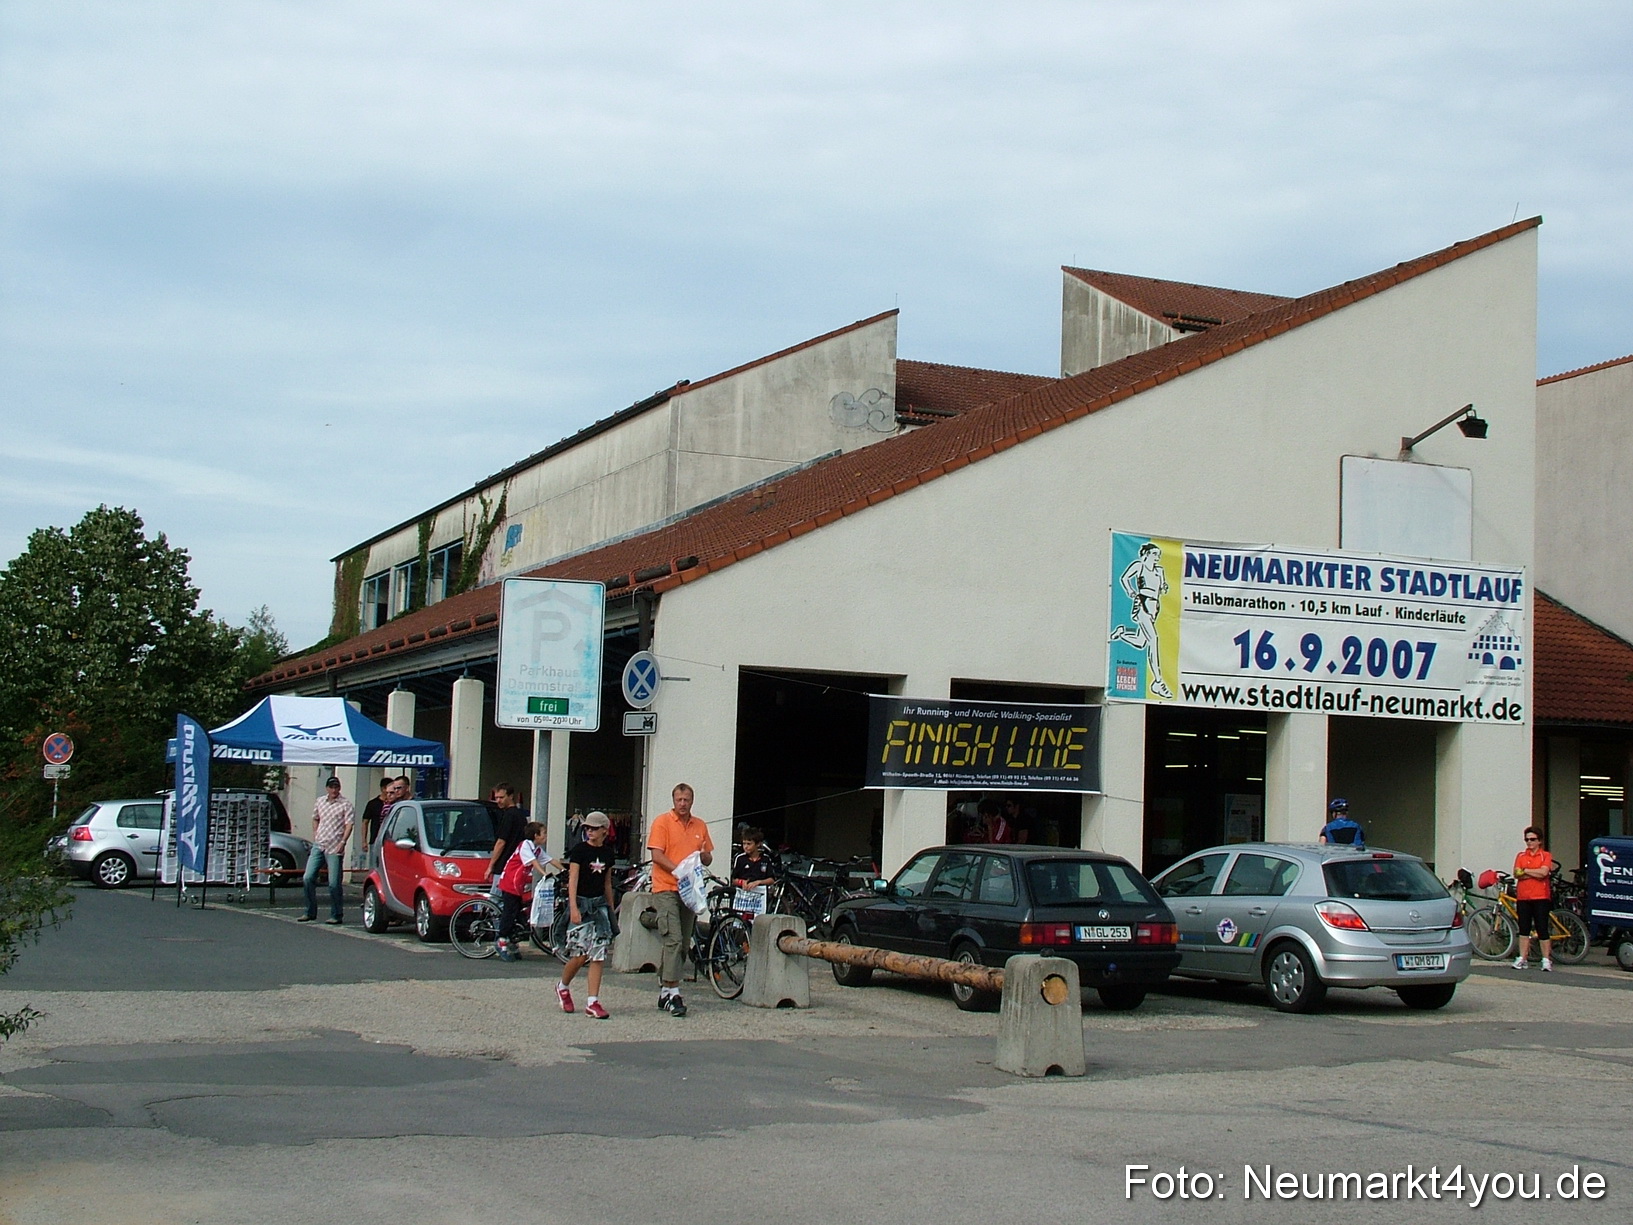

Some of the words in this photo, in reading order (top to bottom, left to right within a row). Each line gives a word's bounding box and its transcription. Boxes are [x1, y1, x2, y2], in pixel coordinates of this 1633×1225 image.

[1184, 552, 1371, 591] NEUMARKTER
[1380, 567, 1523, 603] STADTLAUF
[1192, 592, 1286, 611] Halbmarathon
[1300, 600, 1327, 615] 10,5
[1331, 601, 1351, 615] km
[1355, 603, 1382, 618] Lauf
[1395, 606, 1466, 624] Kinderläufe
[1233, 629, 1437, 681] 16.9.2007
[519, 664, 580, 678] Parkhaus
[539, 700, 558, 713] frei
[1181, 683, 1523, 721] www.stadtlauf-neumarkt.de
[569, 717, 582, 725] Uhr
[903, 706, 916, 715] Ihr
[917, 707, 952, 718] Running-
[954, 708, 970, 717] und
[971, 709, 999, 719] Nordic
[1000, 711, 1073, 722] Walking-Spezialist
[881, 720, 999, 766] FINISH
[1006, 726, 1088, 770] LINE
[1084, 927, 1091, 938] N
[1096, 927, 1108, 938] GL
[1110, 927, 1128, 938] 253
[1426, 956, 1440, 965] 877
